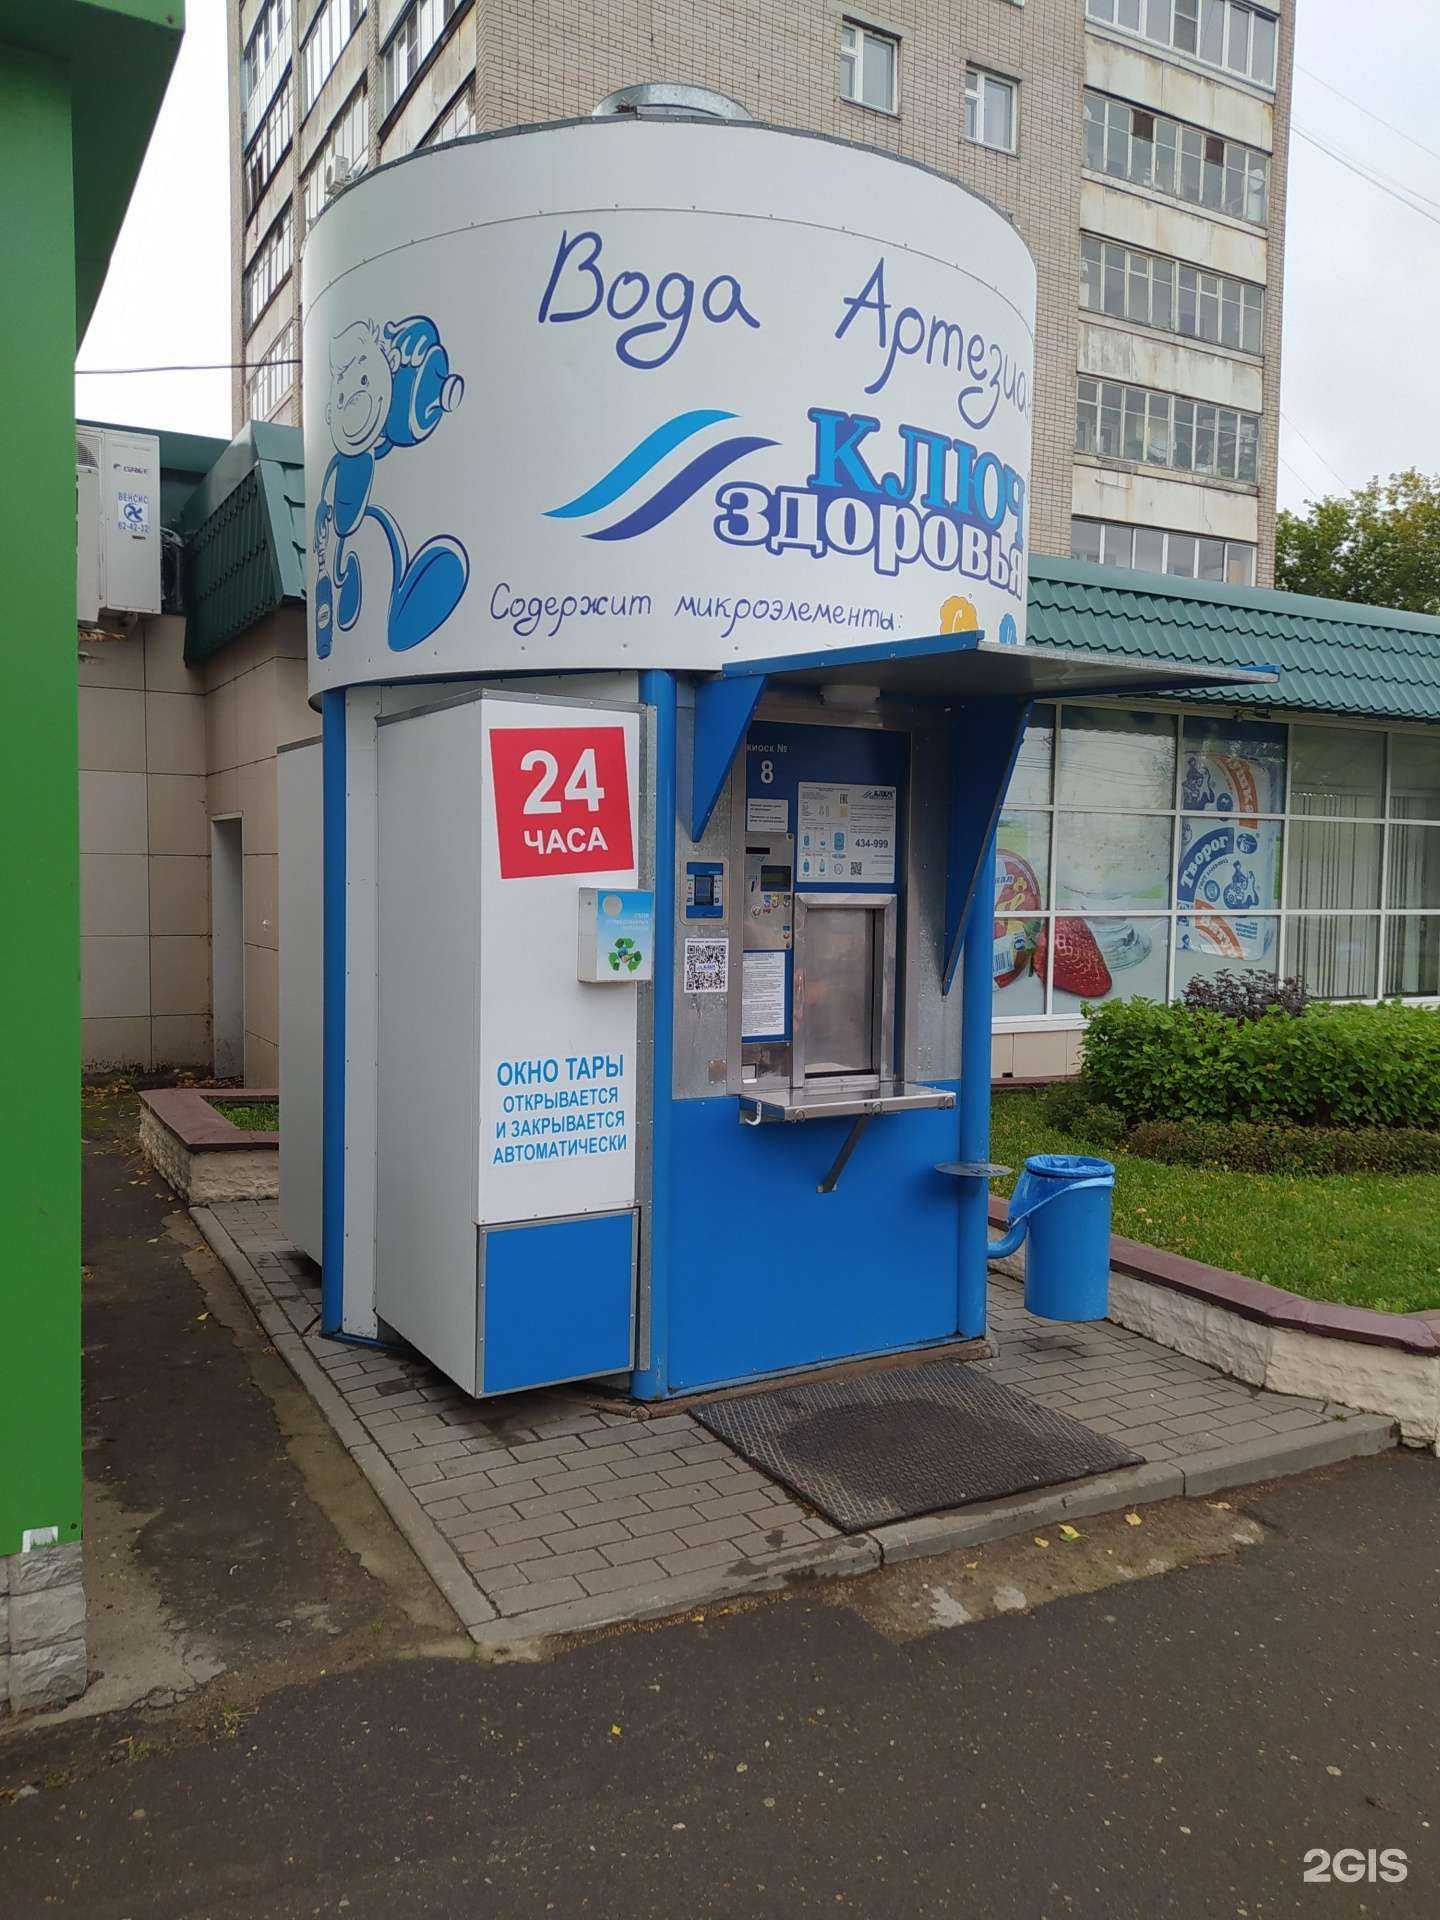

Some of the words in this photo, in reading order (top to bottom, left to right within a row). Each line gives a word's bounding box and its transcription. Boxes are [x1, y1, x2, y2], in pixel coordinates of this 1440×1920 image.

[539, 229, 760, 369] Вода
[835, 257, 1030, 429] Артезиа
[490, 582, 651, 637] Содержит
[674, 596, 903, 638] микроэлементы:
[521, 748, 605, 815] 24
[761, 760, 774, 784] 8
[523, 826, 608, 855] ЧАСА
[855, 838, 889, 848] 434-999
[497, 1058, 559, 1086] ОКНО
[565, 1054, 623, 1080] ТАРЫ
[503, 1087, 618, 1113] ОТКРЫВАЕТСЯ
[496, 1121, 506, 1139] И
[511, 1110, 625, 1138] ЗАКРЫВАЕТСЯ
[493, 1134, 627, 1165] АВТОМАТИЧЕСКИ
